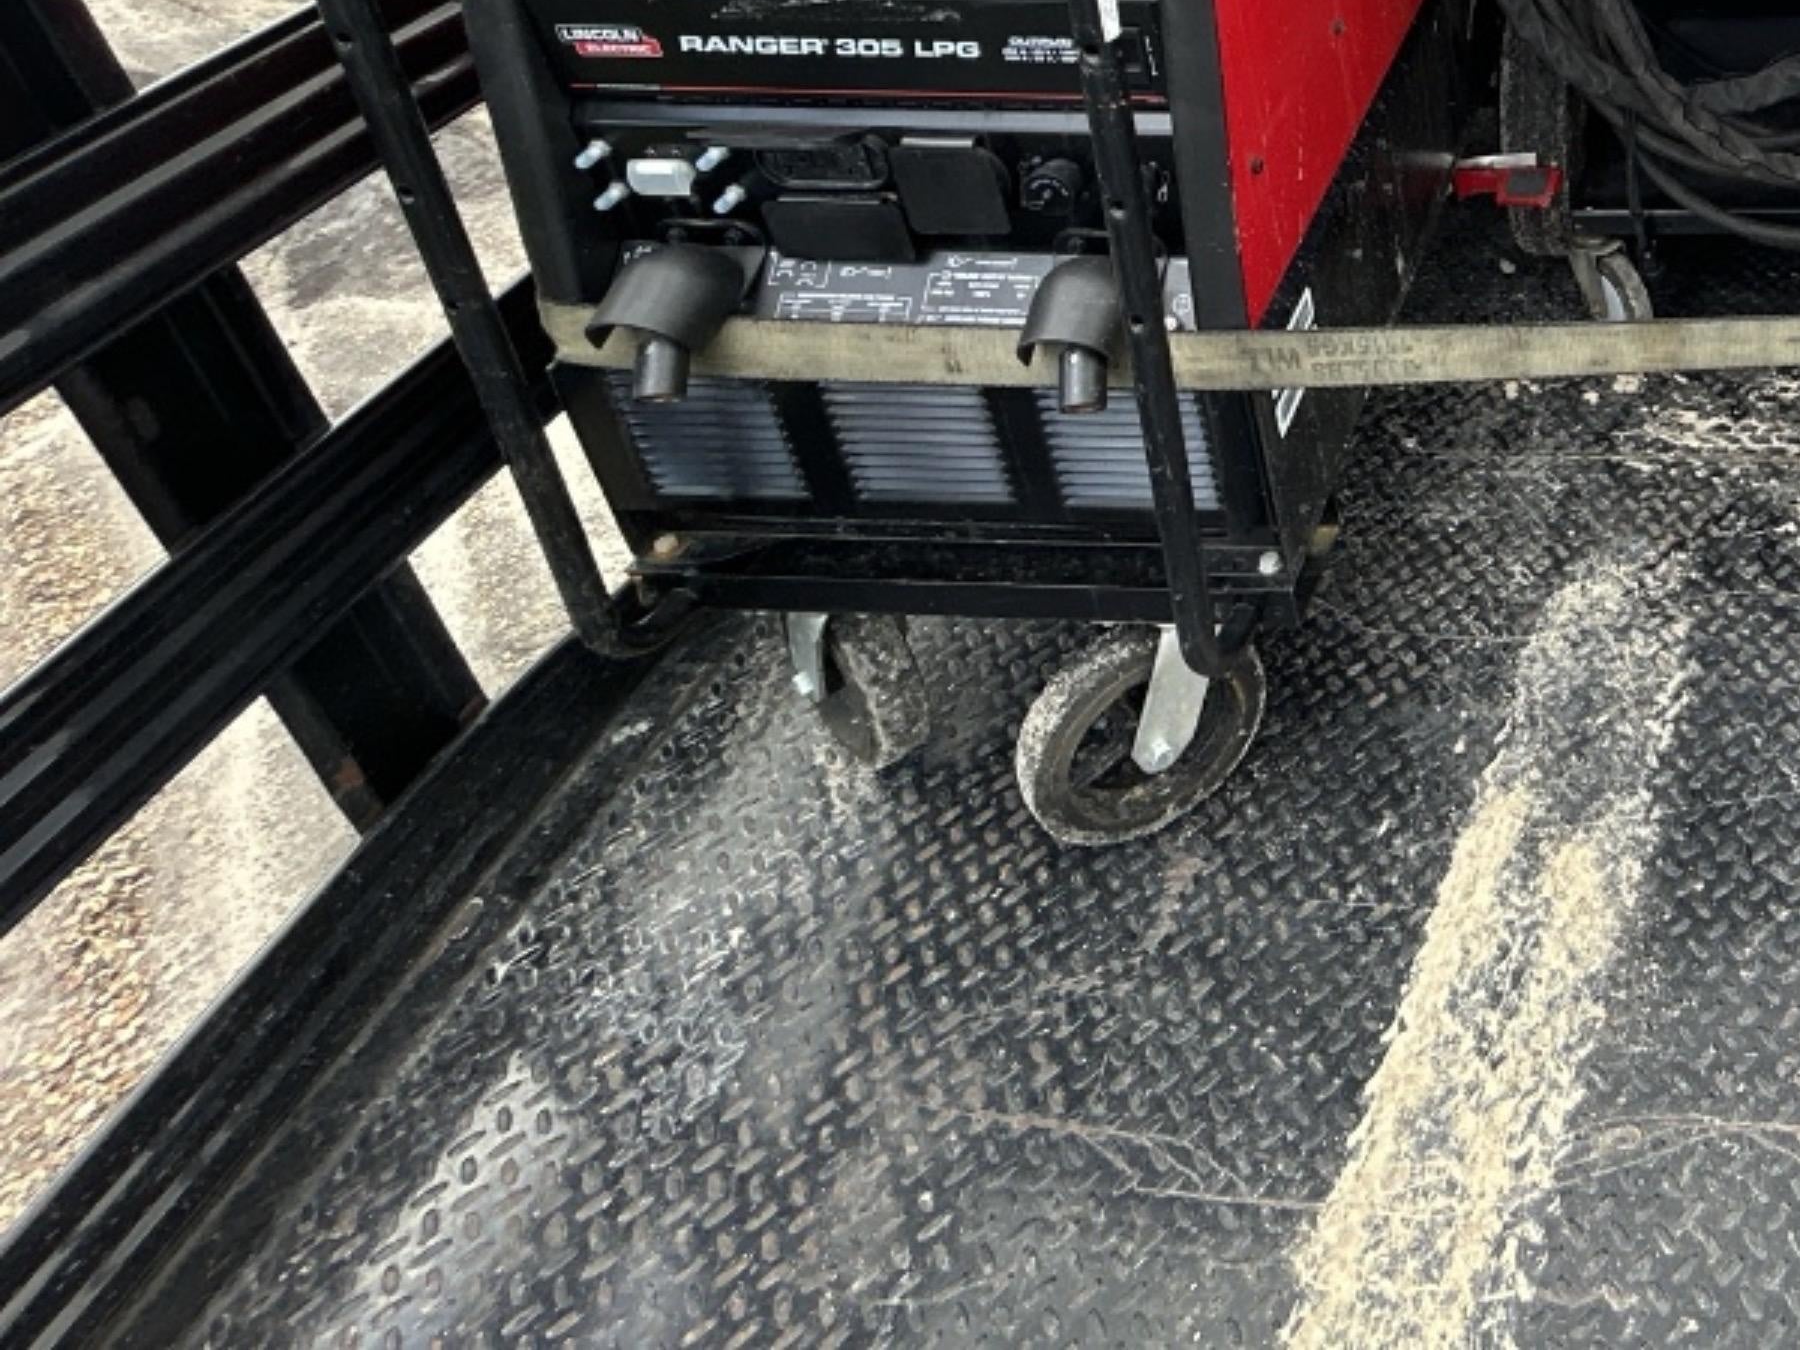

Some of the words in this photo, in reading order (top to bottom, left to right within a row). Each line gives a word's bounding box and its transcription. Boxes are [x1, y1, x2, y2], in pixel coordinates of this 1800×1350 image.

[562, 27, 639, 42] LINCOLN
[679, 34, 823, 56] RANGER
[836, 38, 904, 58] 305
[914, 40, 982, 59] LPG
